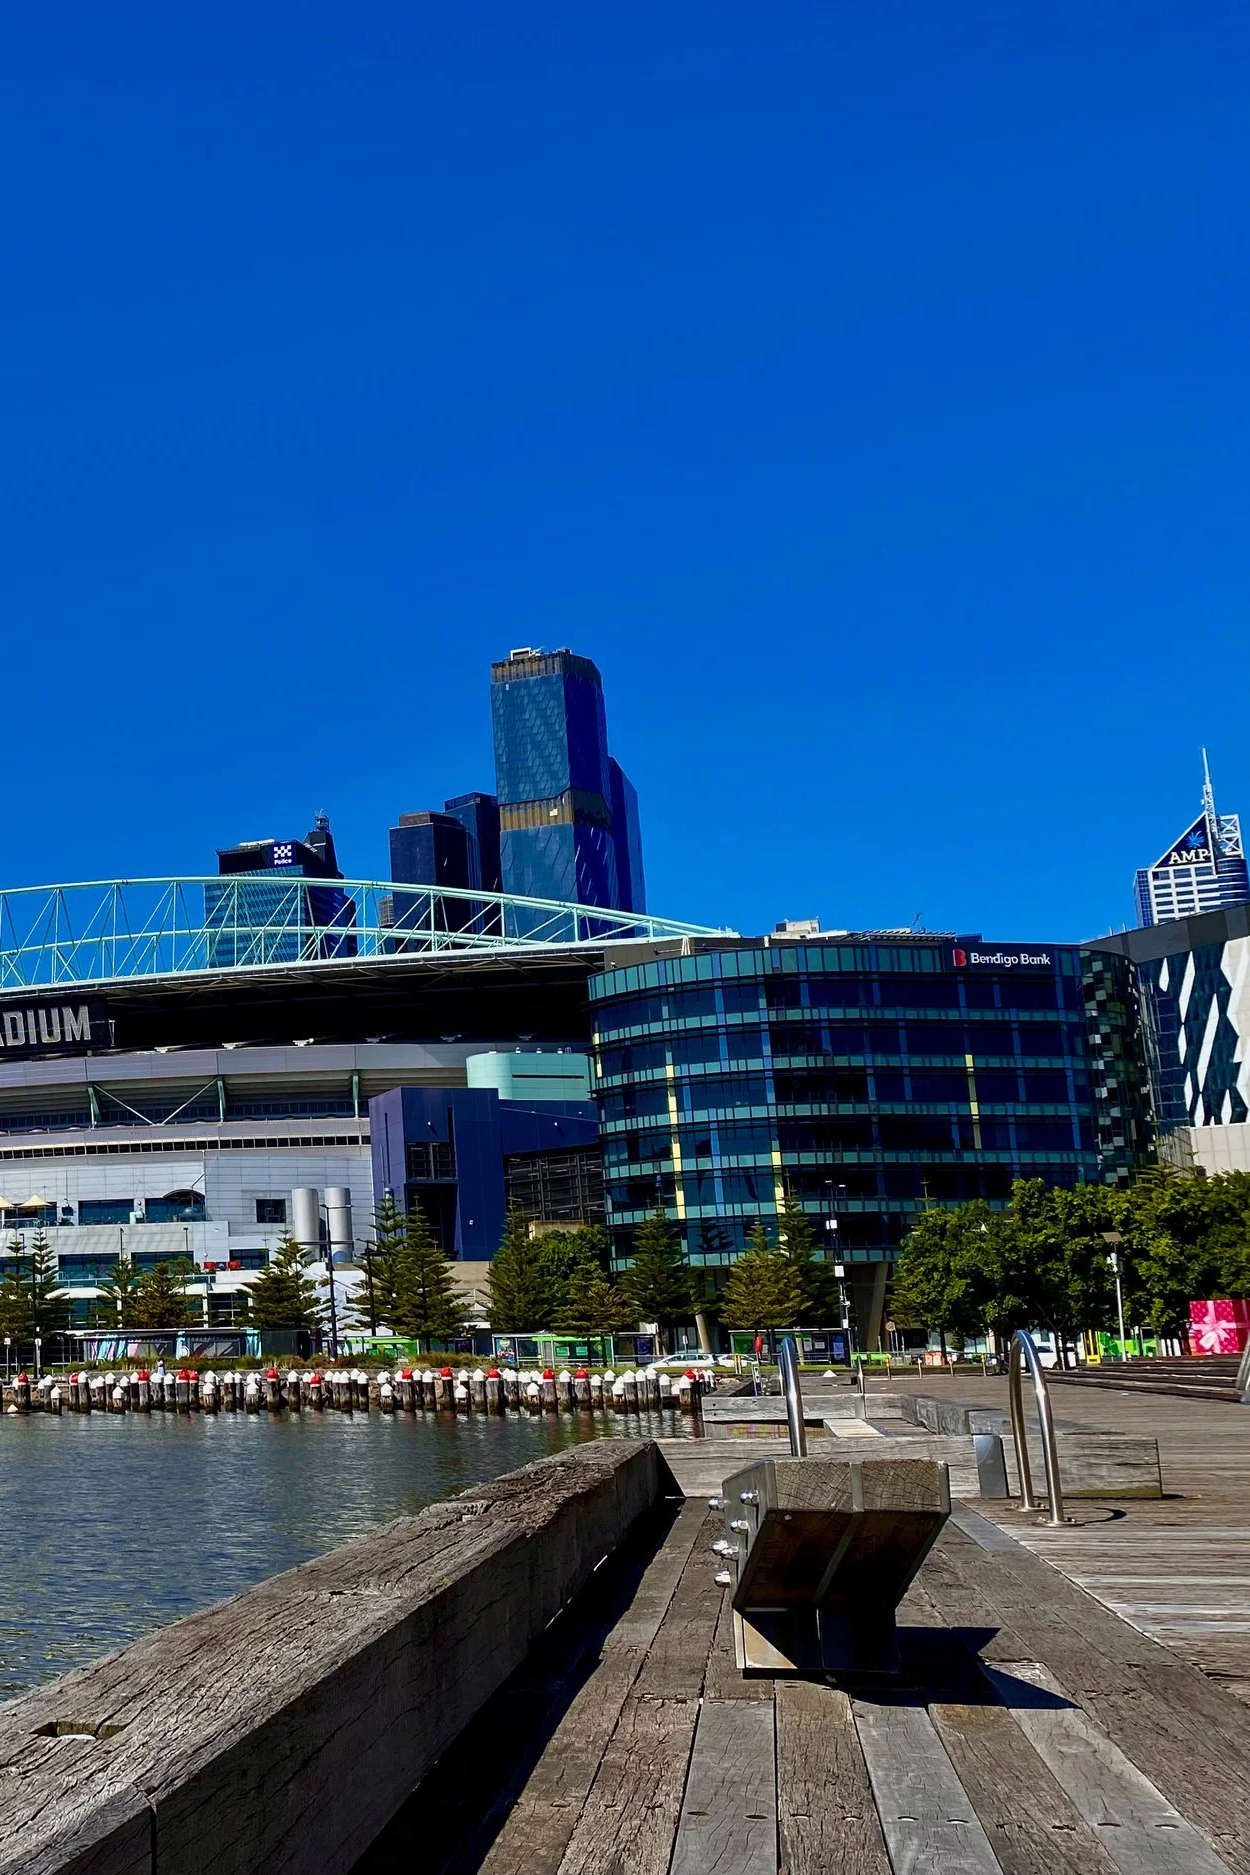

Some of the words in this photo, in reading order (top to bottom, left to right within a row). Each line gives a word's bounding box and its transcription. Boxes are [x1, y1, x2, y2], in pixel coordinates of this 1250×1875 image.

[1168, 849, 1208, 864] AMP
[970, 952, 1019, 967] Bendigo
[1020, 953, 1051, 965] Bank
